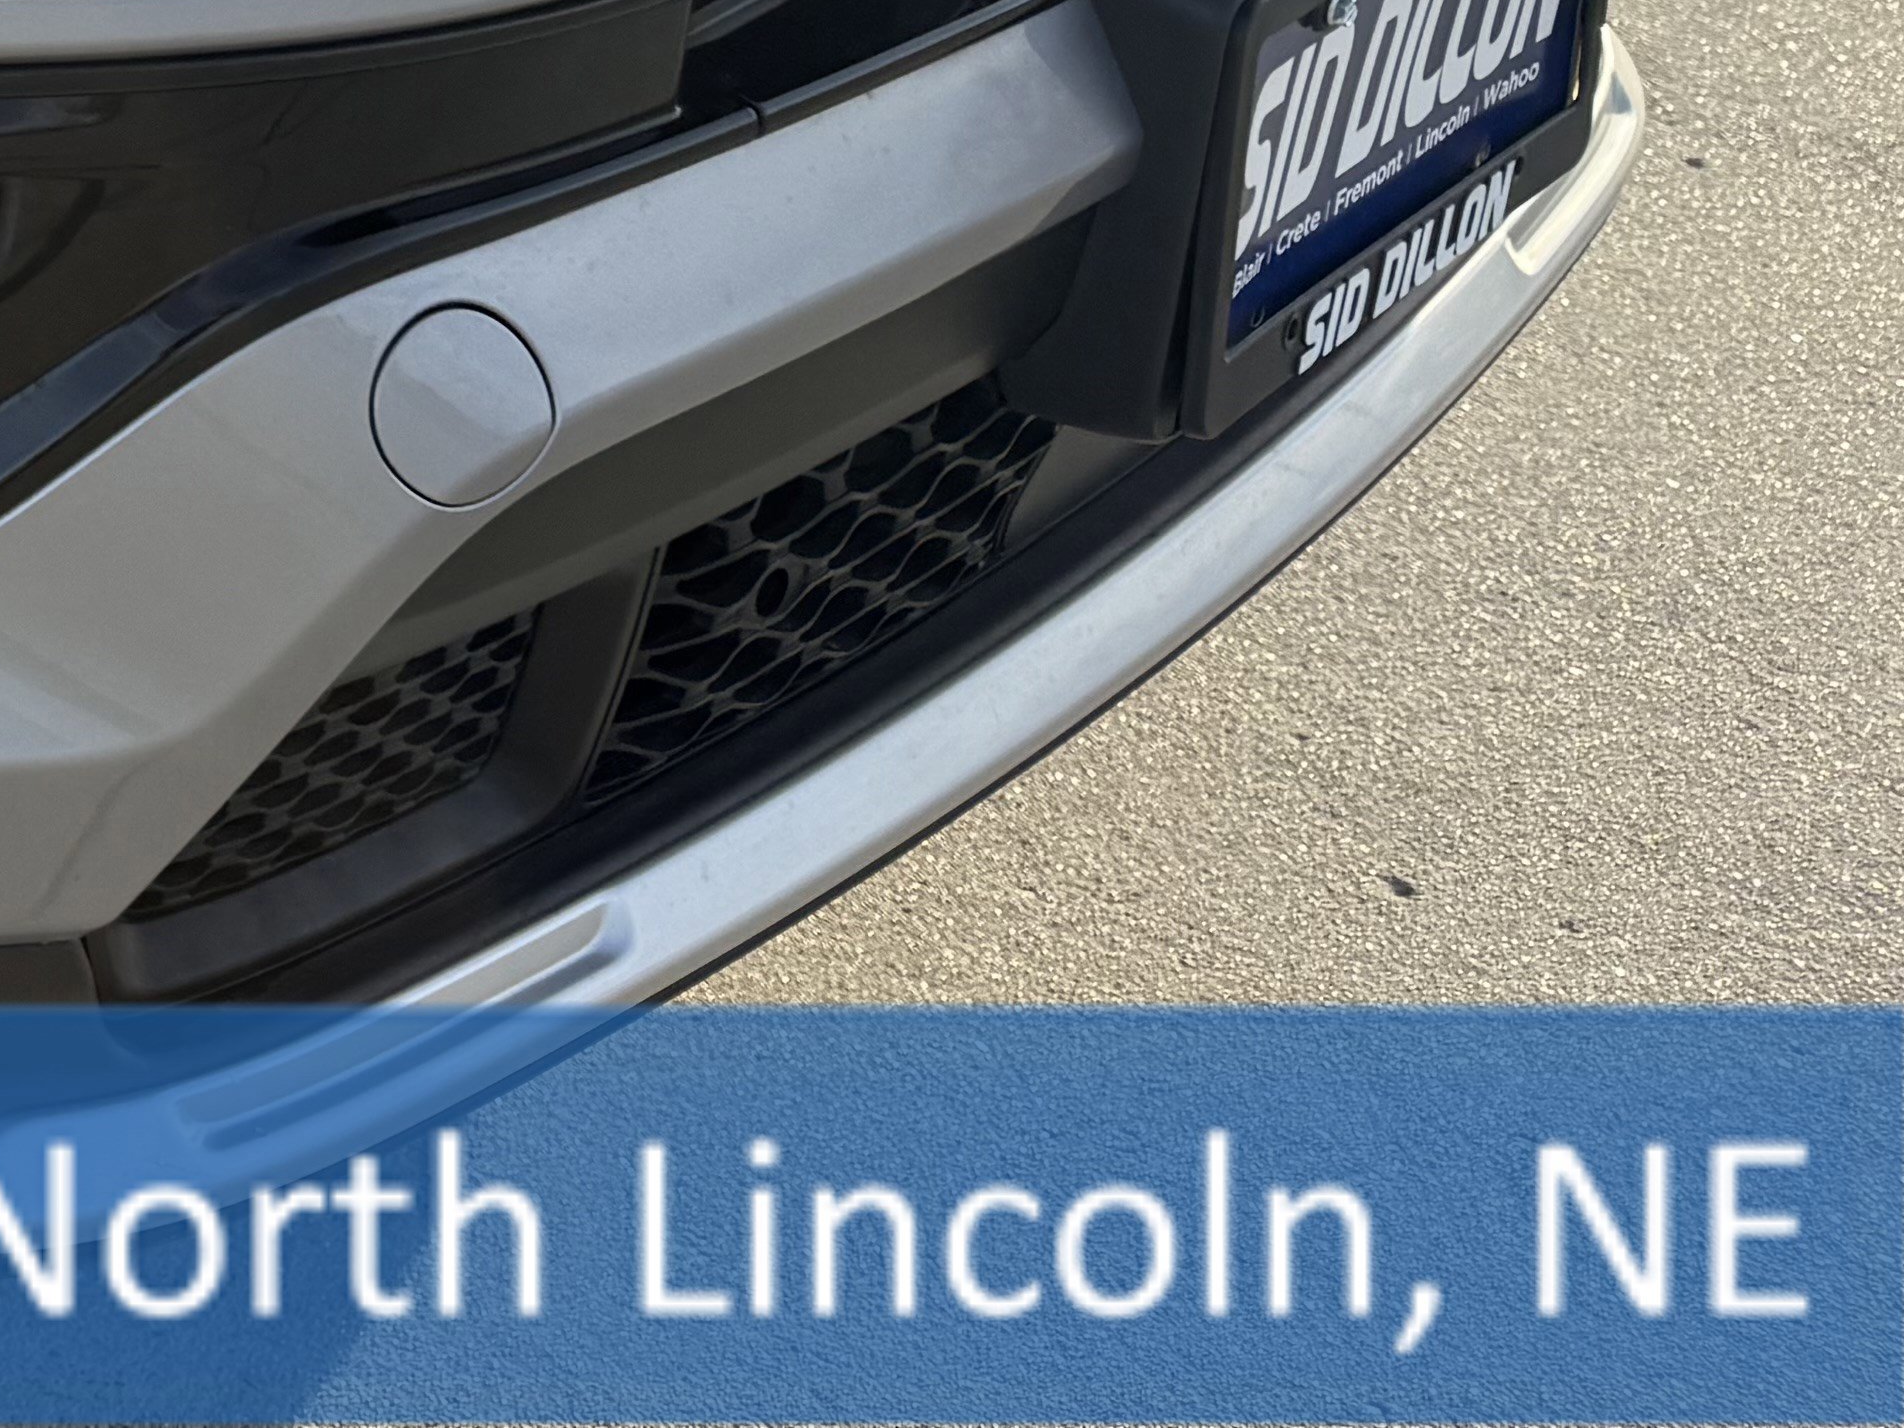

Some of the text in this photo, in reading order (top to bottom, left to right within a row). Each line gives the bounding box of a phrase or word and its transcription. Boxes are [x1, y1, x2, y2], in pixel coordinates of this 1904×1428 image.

[1233, 24, 1355, 262] SID
[1275, 209, 1321, 256] Crete
[1333, 149, 1403, 216] Fremont
[1414, 104, 1471, 159] Lincoln
[1482, 61, 1541, 110] Wahoo
[1298, 159, 1517, 376] SID DILLON
